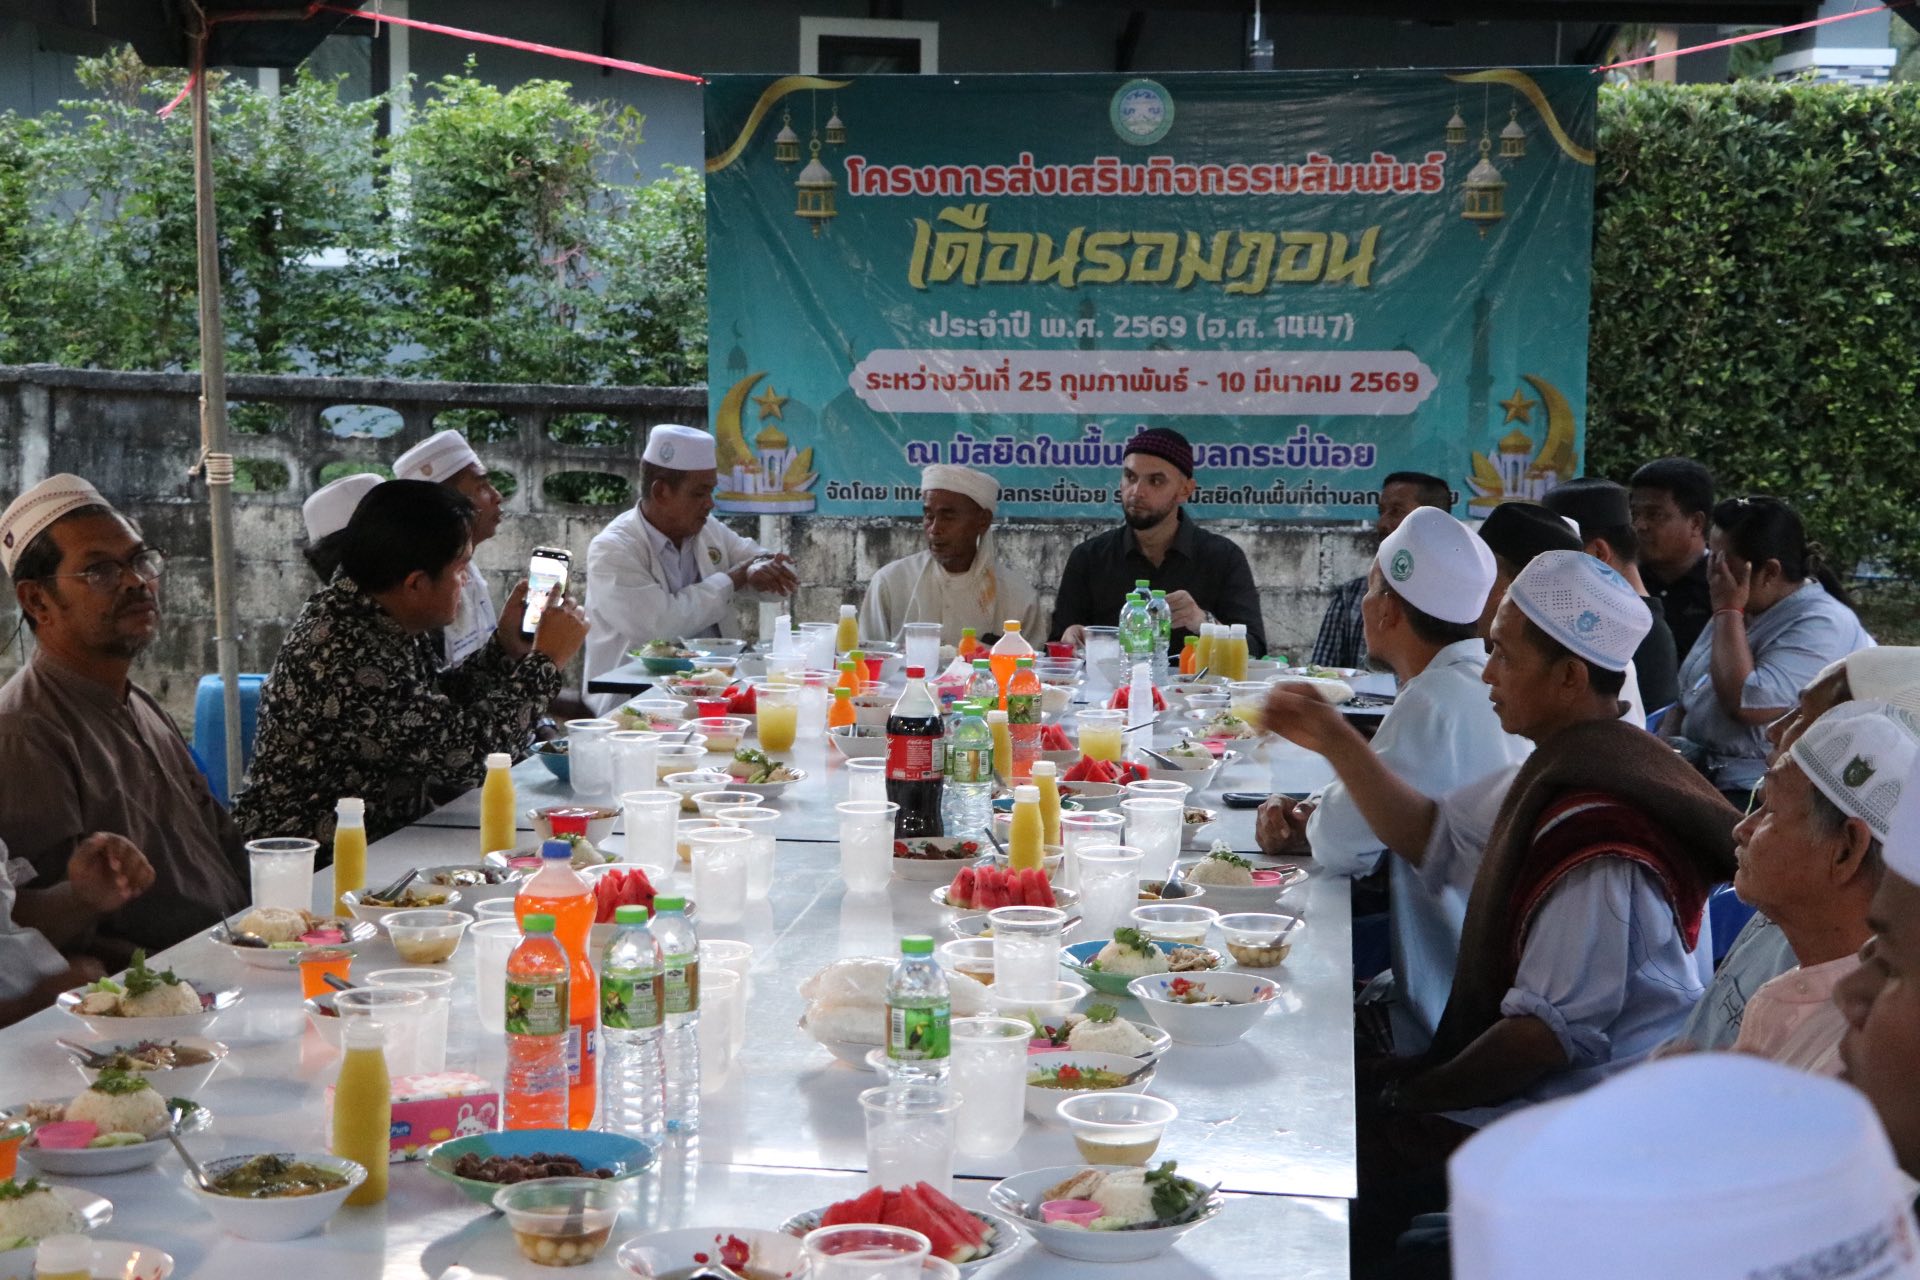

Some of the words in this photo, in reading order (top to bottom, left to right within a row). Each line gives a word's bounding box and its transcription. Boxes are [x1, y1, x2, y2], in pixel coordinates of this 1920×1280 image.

[845, 153, 1446, 195] โครงการส่งเสริมกิจกรรมสัมพันธ์
[908, 203, 1381, 294] เดือนรอมฎอน
[929, 310, 1031, 338] ประจำปี
[1040, 316, 1104, 338] พ.ศ.
[1113, 315, 1187, 338] 2569
[1274, 313, 1354, 341] 1447)
[866, 358, 1010, 392] ระหว่างวันที่
[1019, 371, 1051, 392] 25
[1060, 366, 1190, 400] กุมภาพันธ์
[1217, 371, 1245, 392] 10
[1254, 367, 1341, 393] มีนาคม
[1350, 371, 1419, 393] 2569
[907, 441, 939, 465] ณ
[826, 481, 887, 500] จัดโดย
